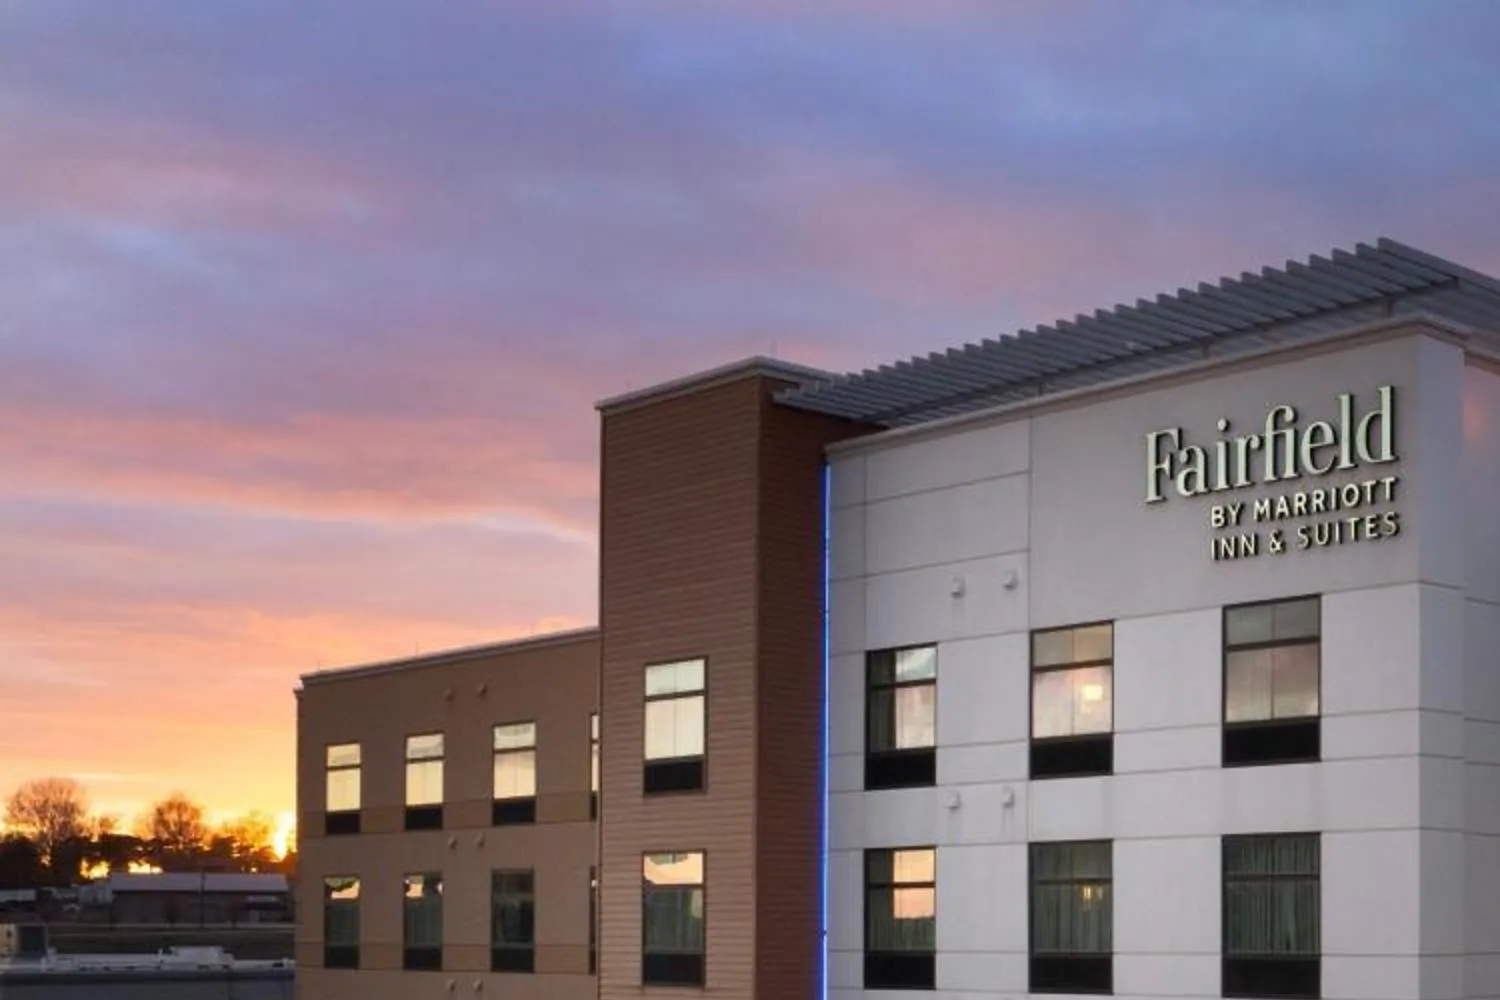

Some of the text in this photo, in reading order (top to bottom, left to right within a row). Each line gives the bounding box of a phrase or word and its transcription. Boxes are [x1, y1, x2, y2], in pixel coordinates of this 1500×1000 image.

[1145, 385, 1397, 503] Fairfield
[1210, 477, 1398, 528] BY MARRIOTT
[1210, 511, 1399, 561] INN & SUITES
